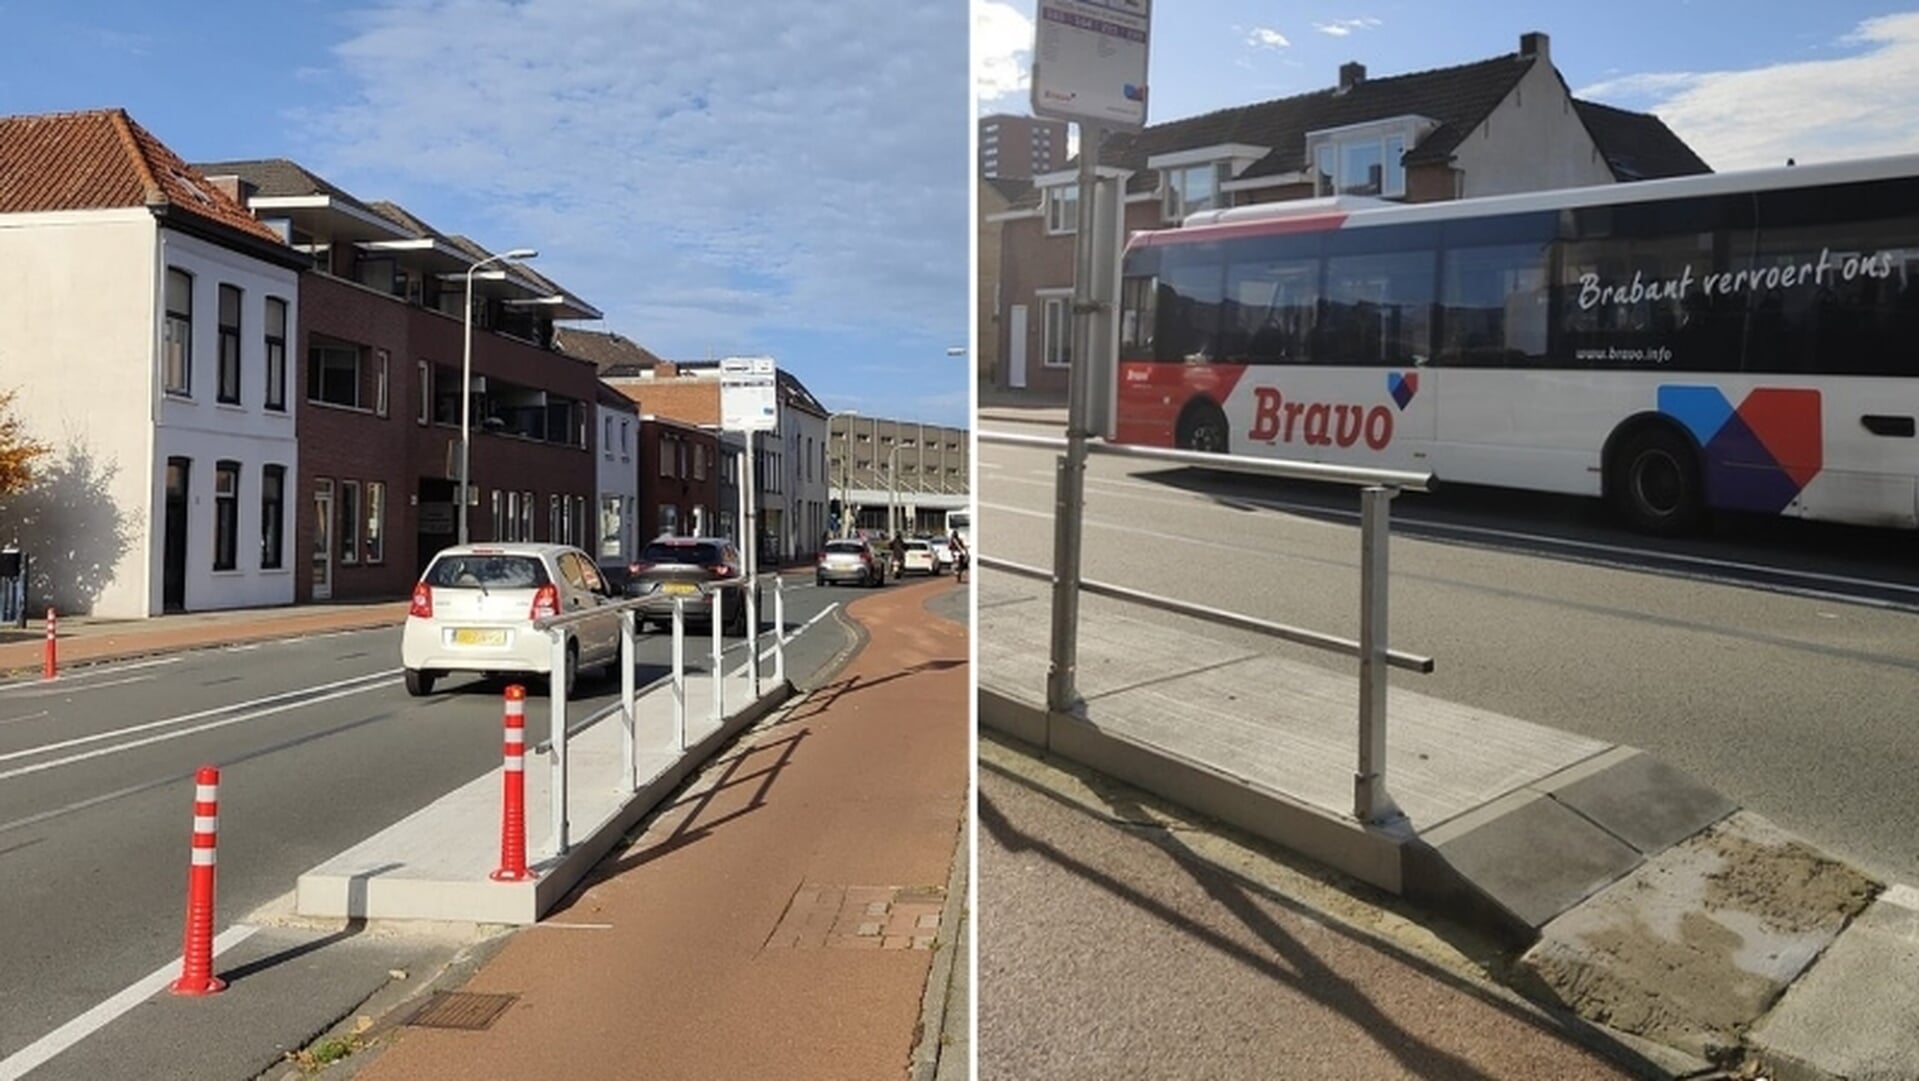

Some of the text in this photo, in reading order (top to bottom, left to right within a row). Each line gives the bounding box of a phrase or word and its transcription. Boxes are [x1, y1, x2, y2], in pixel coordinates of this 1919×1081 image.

[1577, 247, 1894, 310] Brabant vervoert ons
[1575, 345, 1673, 364] www.bravo.info
[1248, 386, 1394, 451] Bravo
